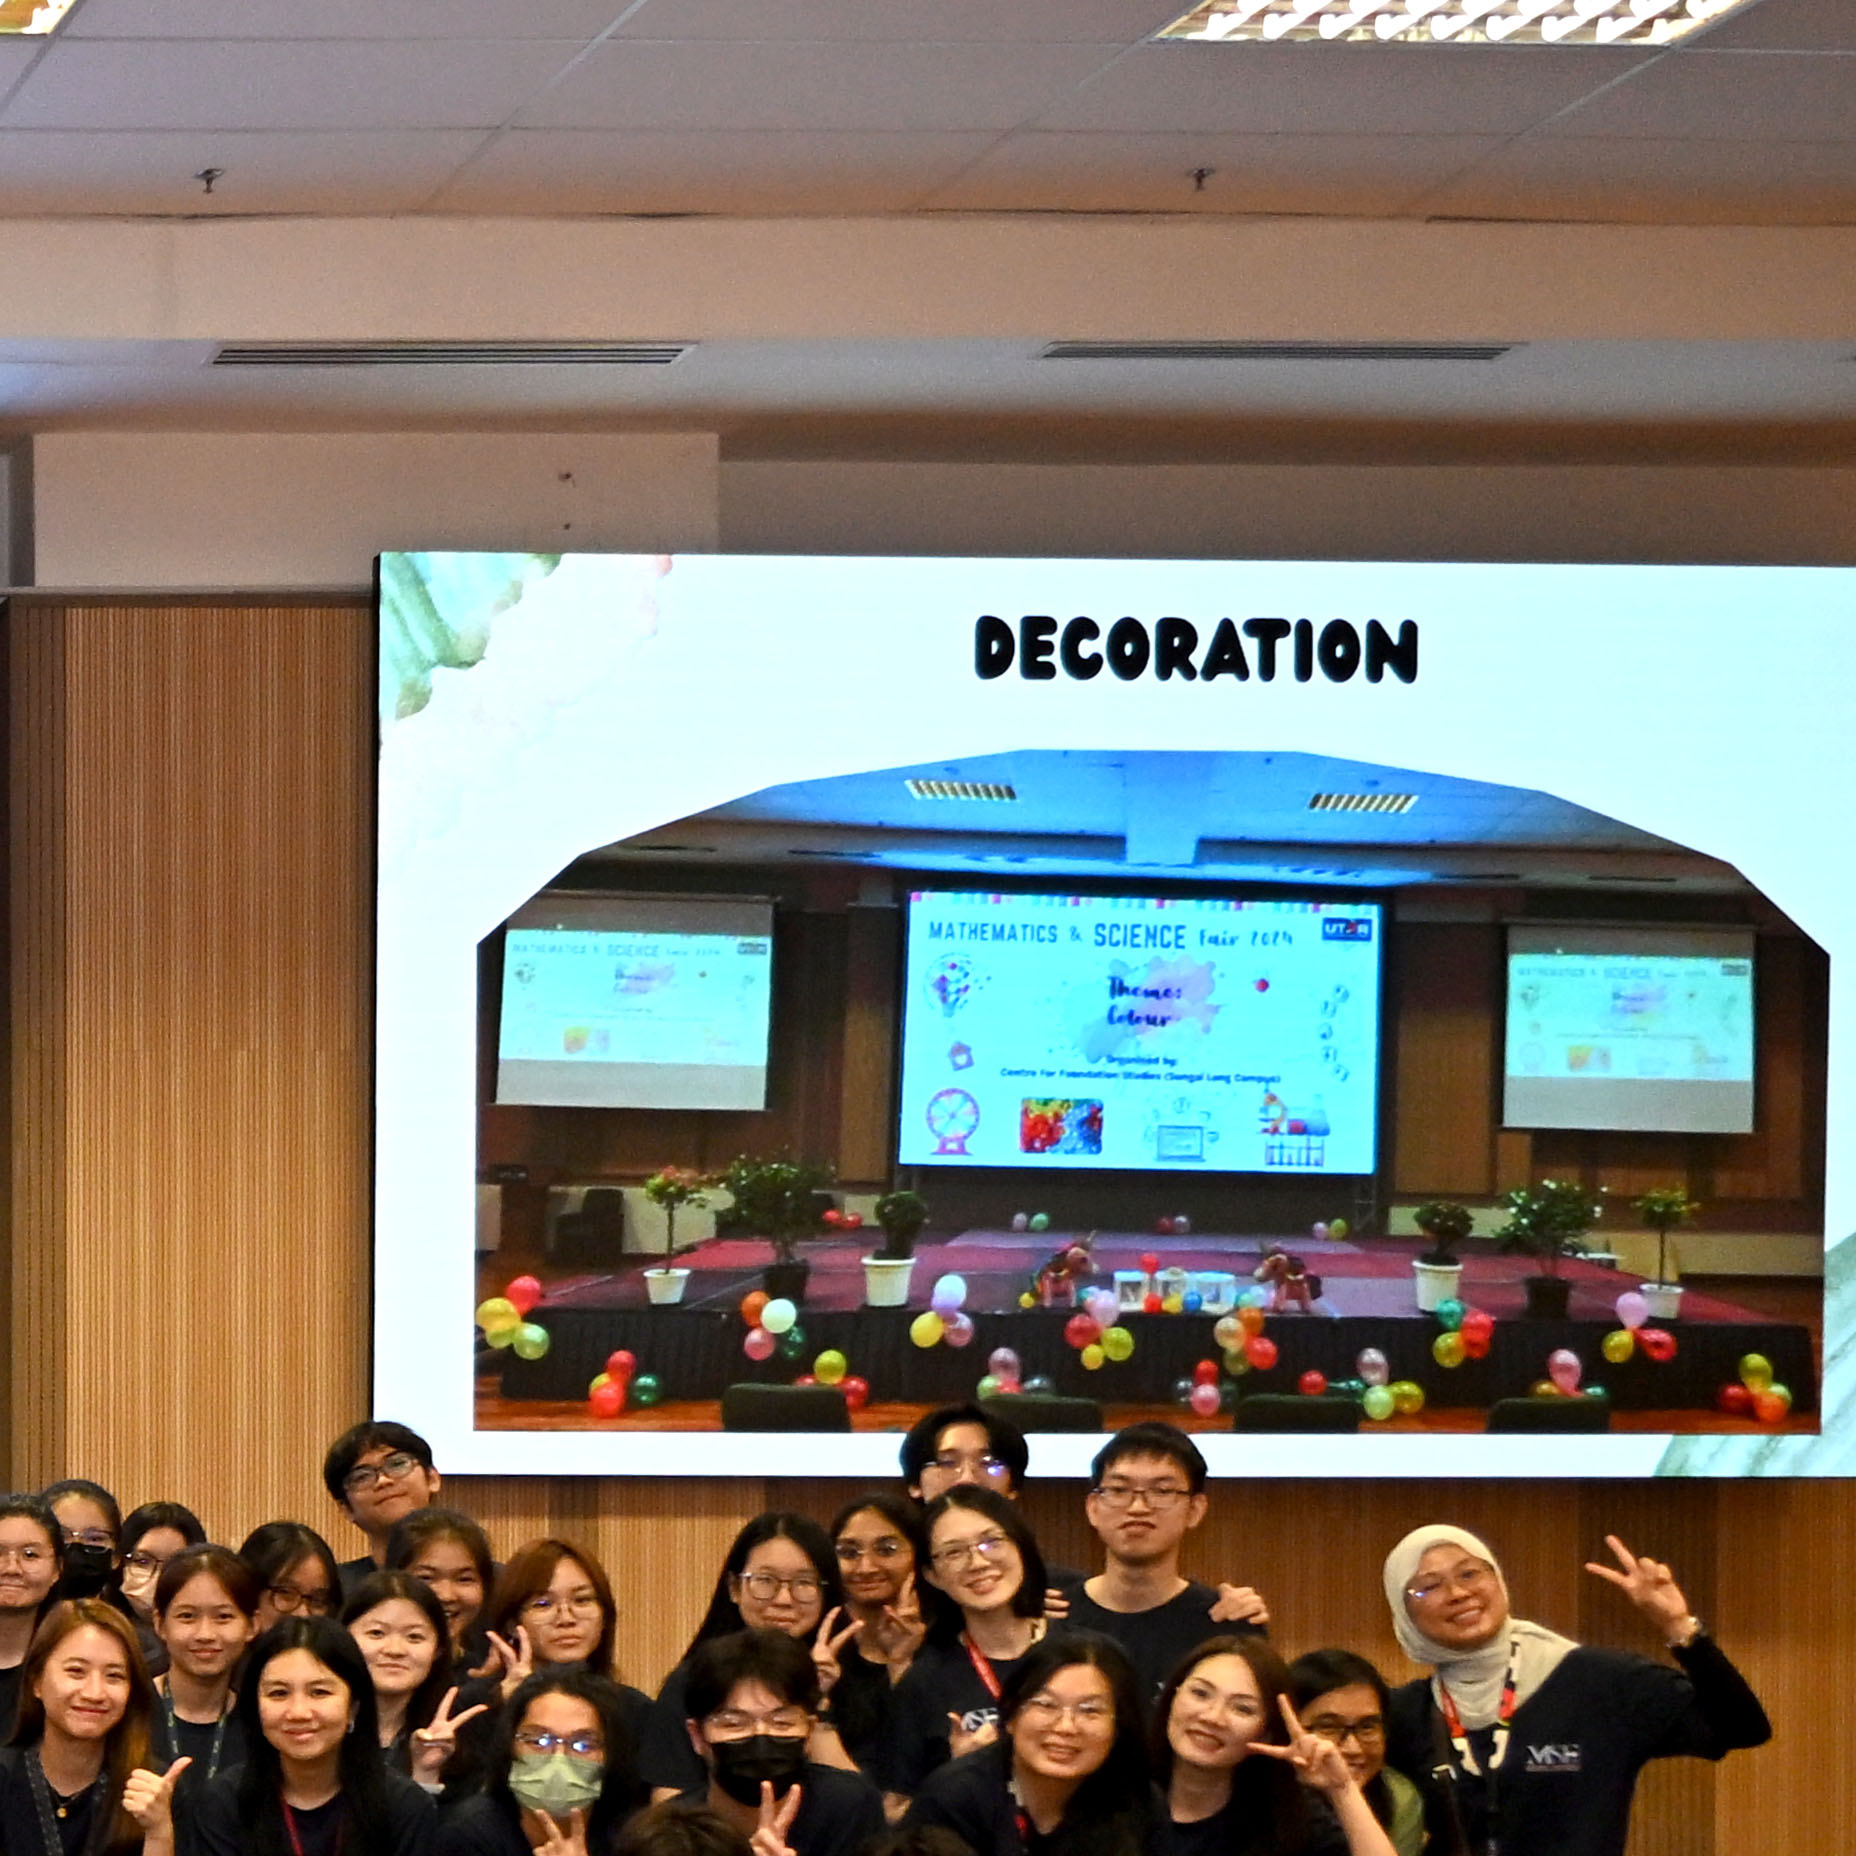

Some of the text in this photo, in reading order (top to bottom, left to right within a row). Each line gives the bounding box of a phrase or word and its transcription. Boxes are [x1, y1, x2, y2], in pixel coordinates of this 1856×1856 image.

[975, 615, 1419, 684] DECORATION
[928, 921, 1057, 943] MATHEMATICS
[1069, 926, 1084, 944] &
[1094, 923, 1186, 950] SCIENCE
